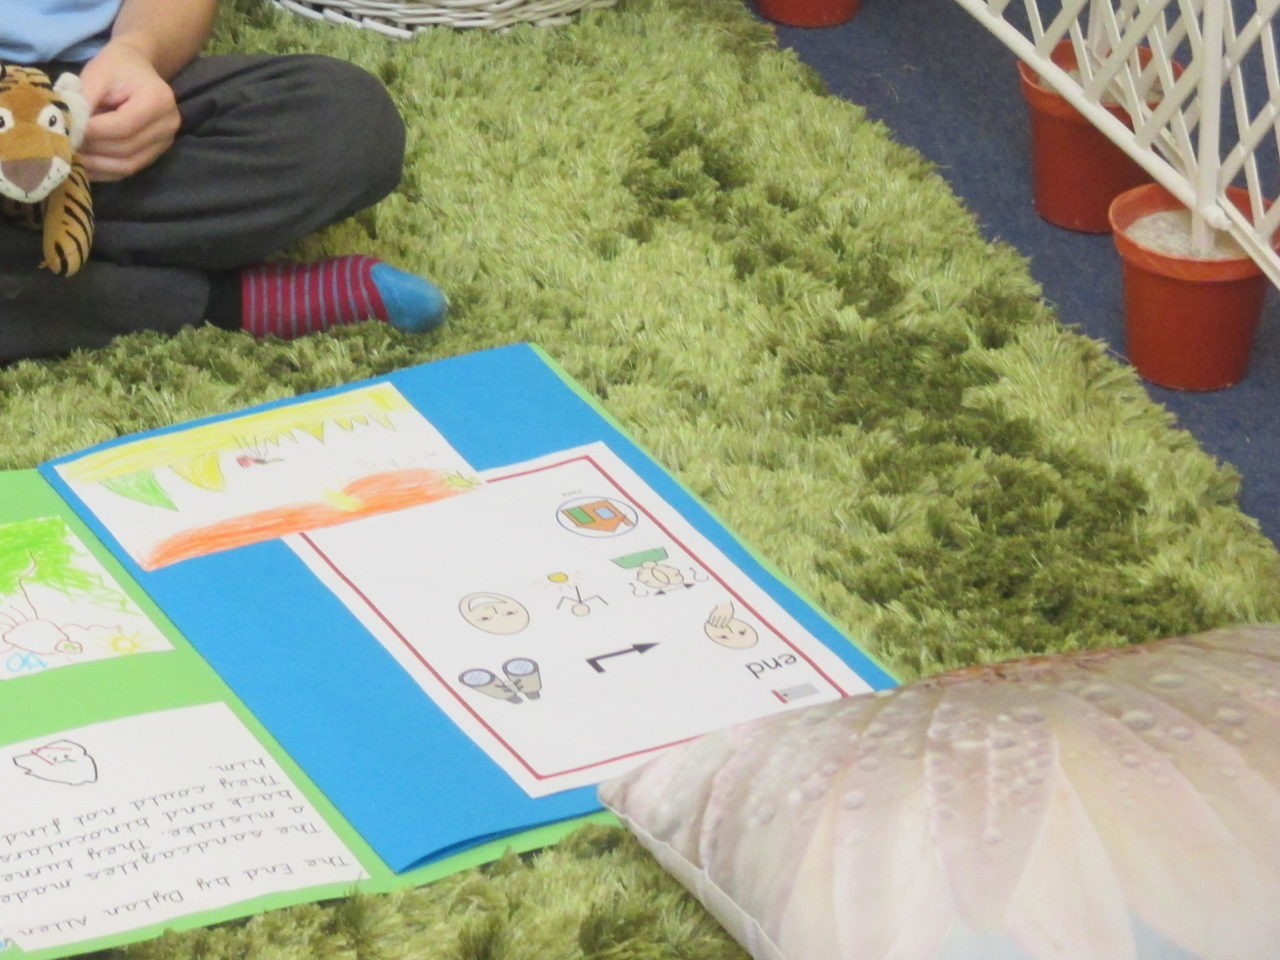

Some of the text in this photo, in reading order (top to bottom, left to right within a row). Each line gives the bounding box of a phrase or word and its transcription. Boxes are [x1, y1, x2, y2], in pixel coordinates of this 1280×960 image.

[745, 653, 797, 679] end
[209, 757, 266, 772] him.
[228, 789, 293, 809] back
[288, 805, 304, 814] a
[1, 774, 281, 846] They could not find
[162, 801, 214, 822] and
[161, 809, 275, 837] mistake.
[276, 822, 322, 835] The
[87, 839, 151, 861] They
[19, 855, 350, 936] The End by Dylan Allen
